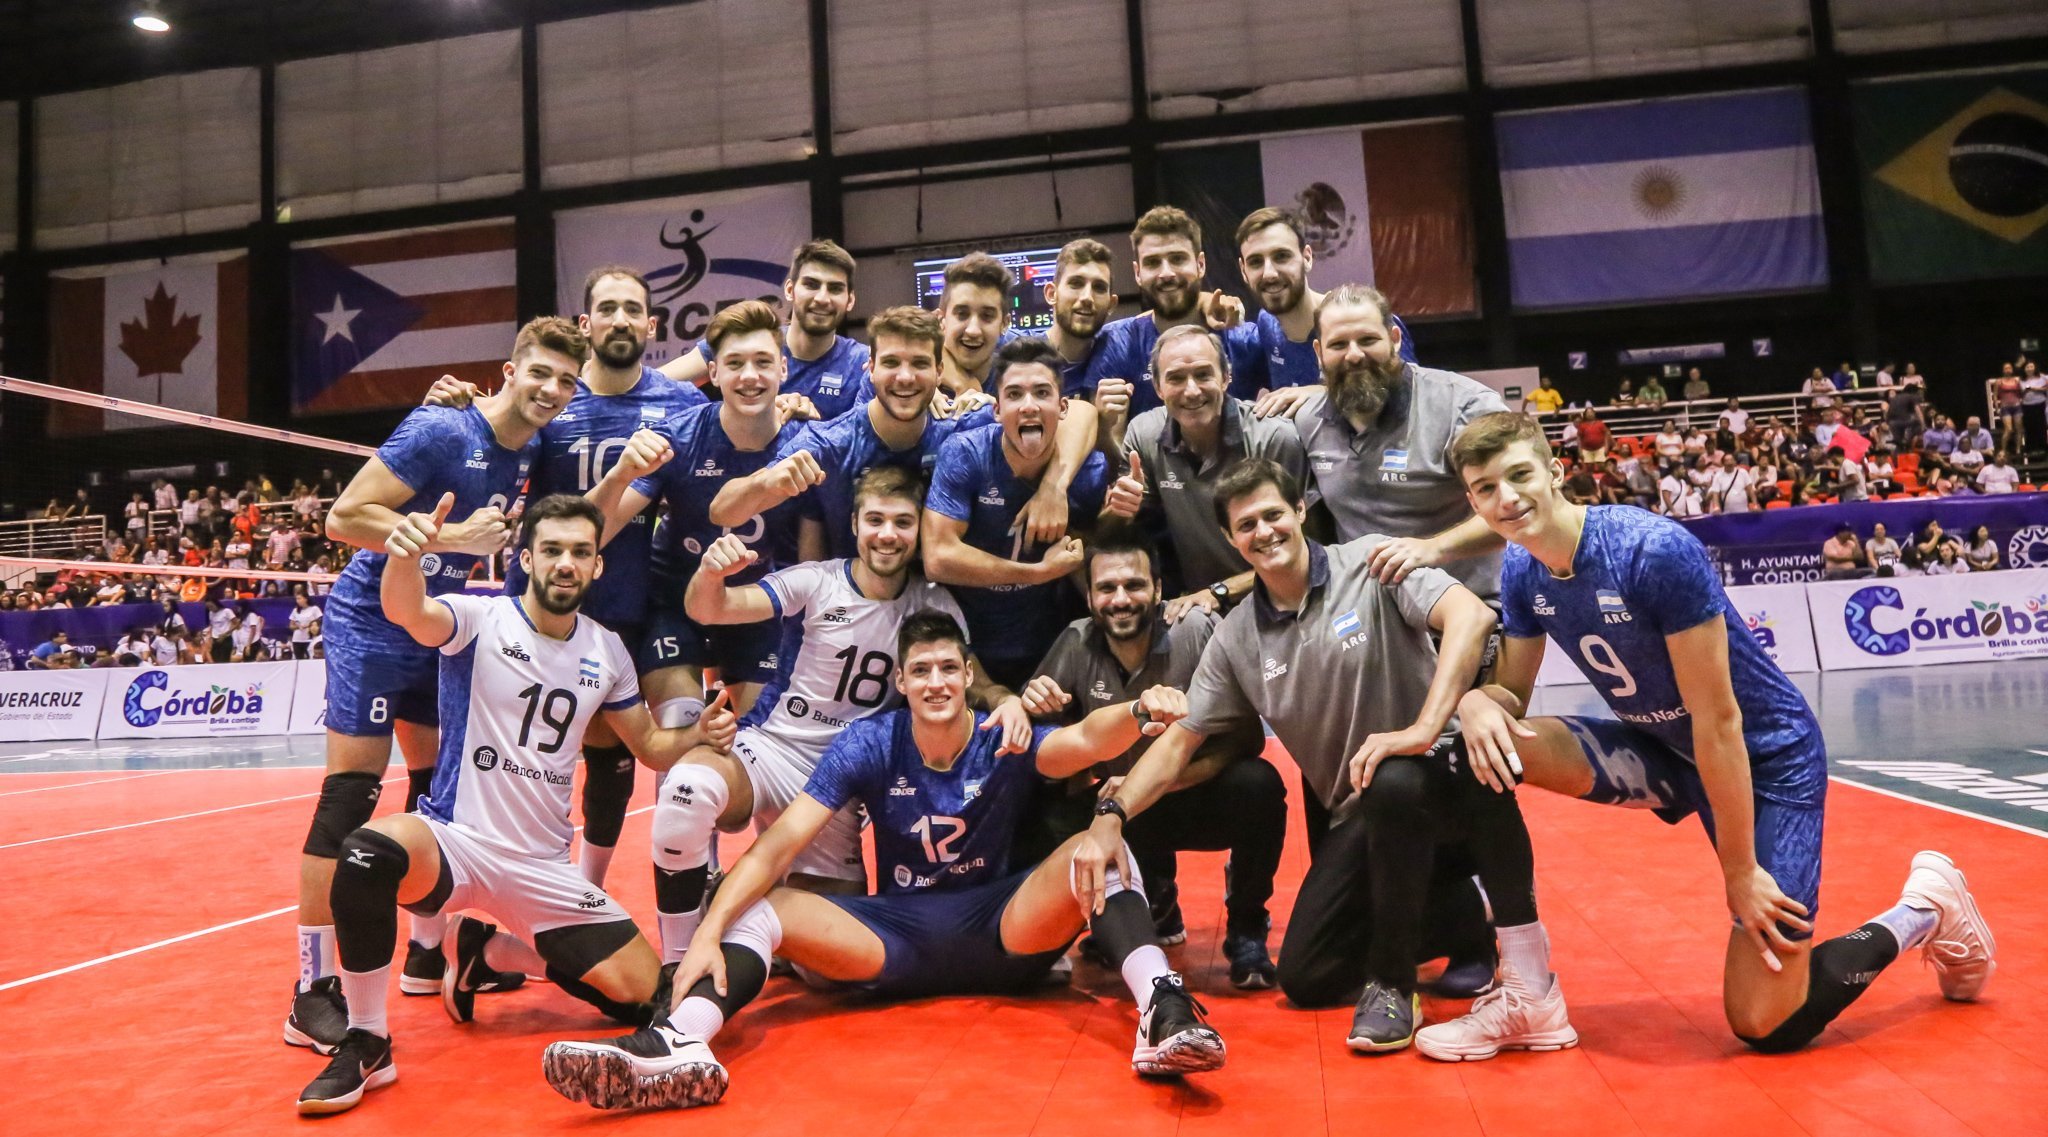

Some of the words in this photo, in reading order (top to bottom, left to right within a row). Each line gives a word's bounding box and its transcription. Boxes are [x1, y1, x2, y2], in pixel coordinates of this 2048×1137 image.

[818, 387, 841, 396] ARG
[1381, 472, 1408, 482] ARG
[1604, 611, 1633, 625] ARG
[652, 636, 681, 660] 15
[1341, 632, 1368, 653] ARG
[833, 644, 895, 709] 18
[1579, 634, 1638, 698] 9
[578, 677, 601, 690] ARG
[0, 691, 84, 708] VERACRUZ
[369, 696, 388, 724] 8
[517, 682, 579, 754] 19
[501, 758, 542, 780] Banco
[909, 814, 967, 864] 12
